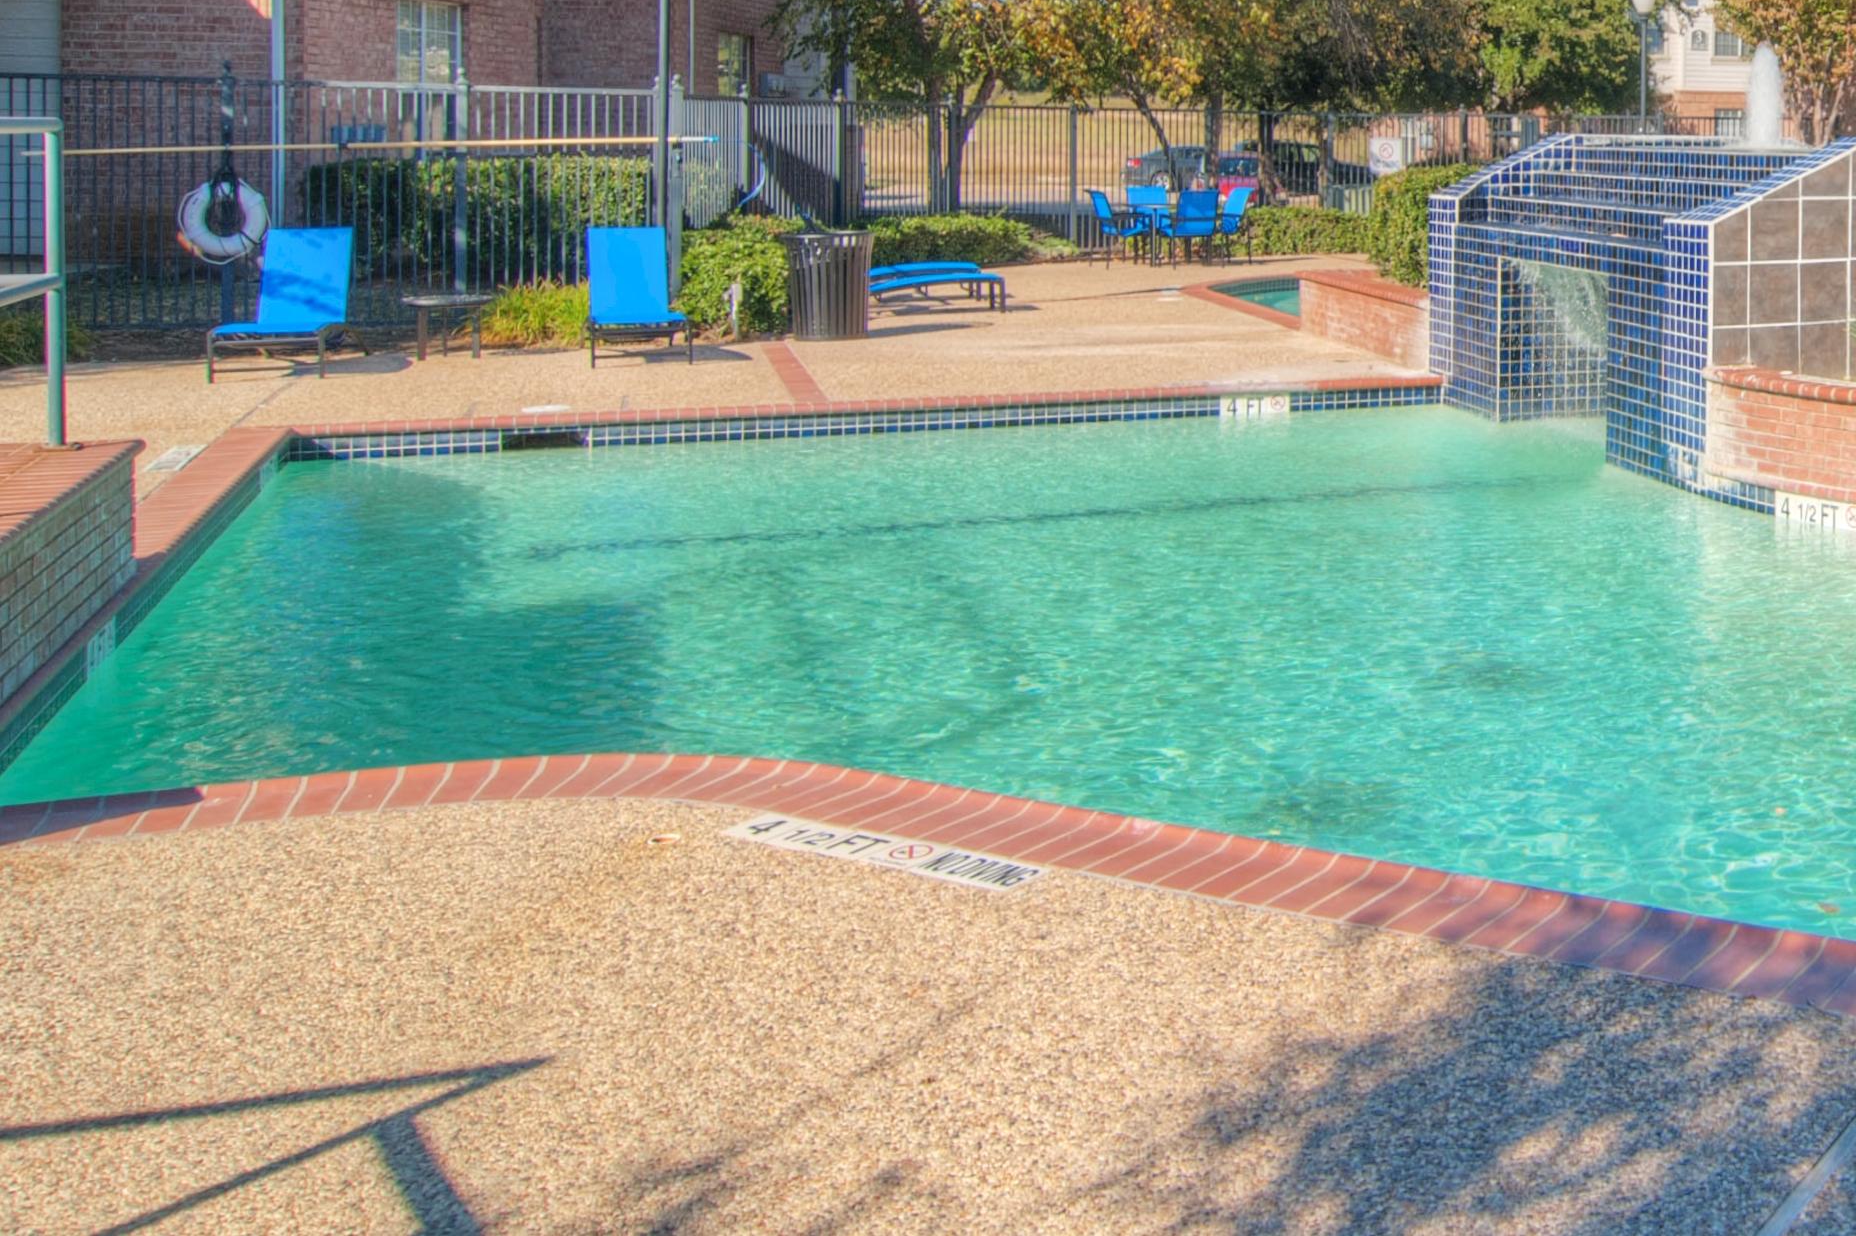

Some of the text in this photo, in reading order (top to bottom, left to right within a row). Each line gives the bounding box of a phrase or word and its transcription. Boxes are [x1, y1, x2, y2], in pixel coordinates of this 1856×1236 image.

[1227, 396, 1264, 419] 4 FT
[1781, 497, 1839, 532] 4 1/2 FT
[748, 820, 1040, 887] 4 1/2 FT NO DIVING
